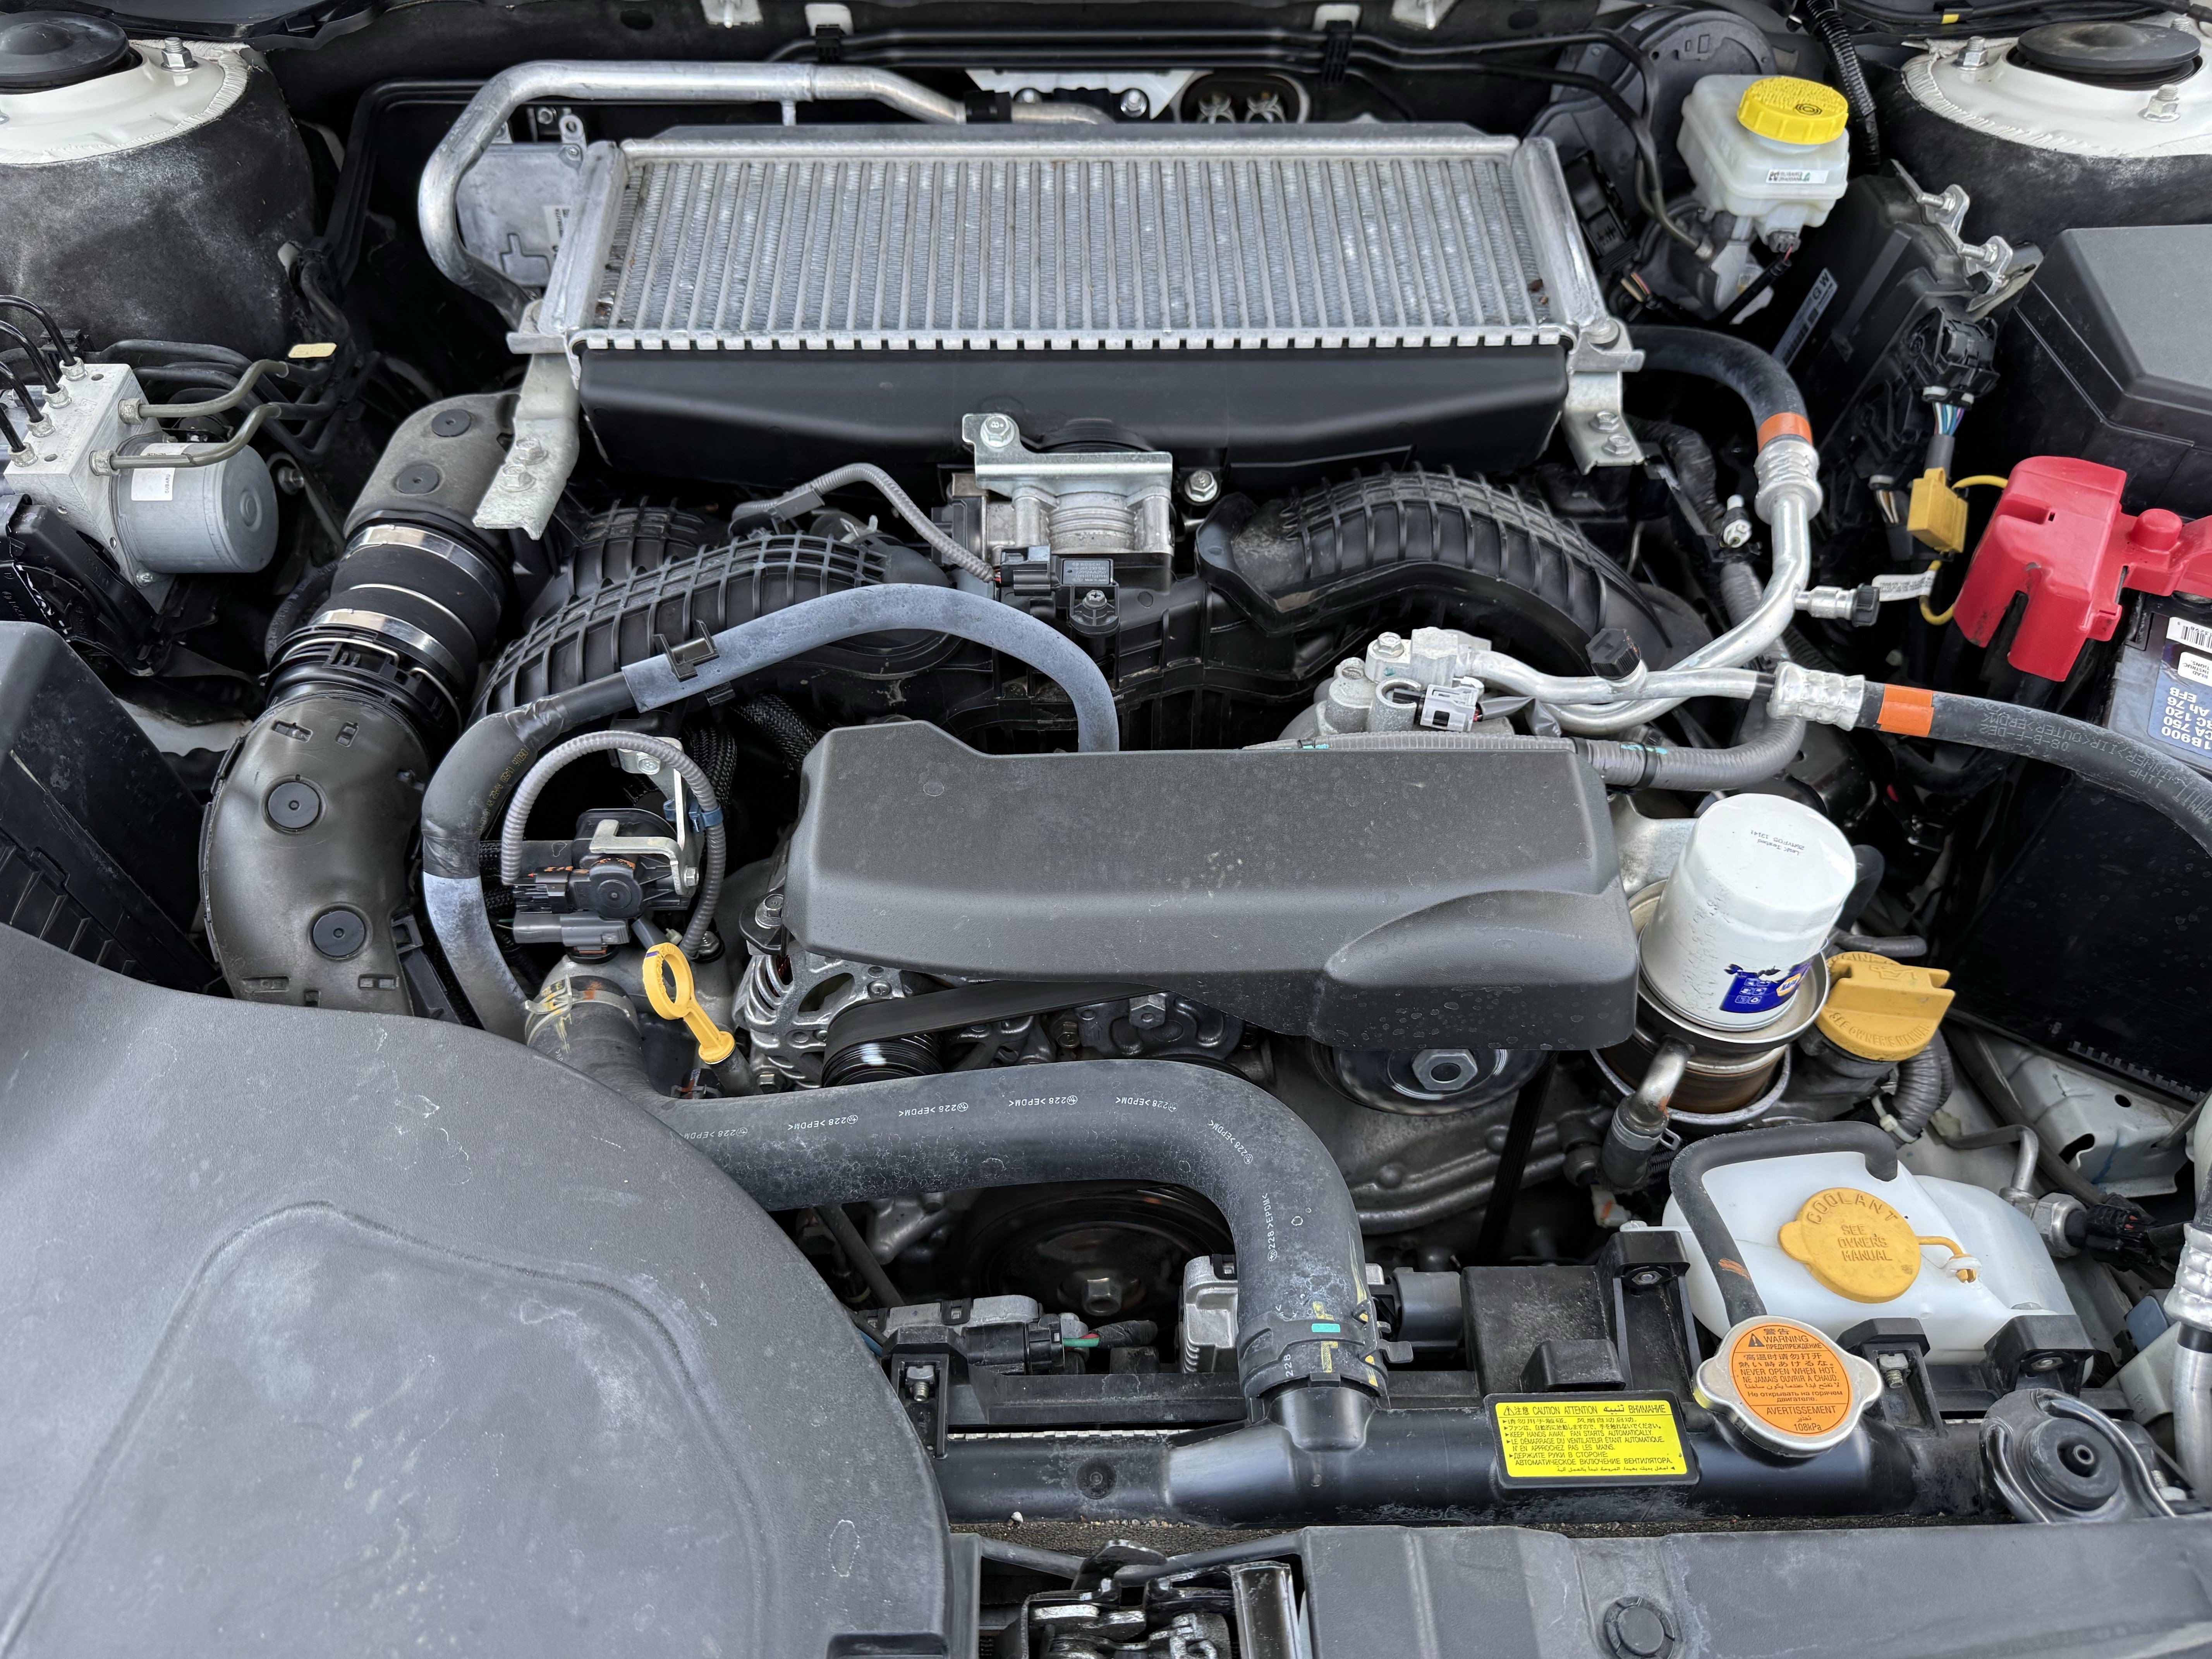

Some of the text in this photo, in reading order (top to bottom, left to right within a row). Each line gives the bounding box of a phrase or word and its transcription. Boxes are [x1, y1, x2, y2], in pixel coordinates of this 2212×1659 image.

[2169, 687, 2197, 703] EFB
[2167, 696, 2210, 717] Ah 76
[2165, 706, 2192, 721] 120
[2163, 716, 2190, 733] 750
[1829, 1012, 1930, 1048] SEE OWNER'S MANUAL
[939, 1104, 957, 1113] 228
[1152, 1100, 1168, 1109] 228
[828, 1116, 847, 1126] 228
[718, 1129, 736, 1138] 228
[1234, 1142, 1248, 1156] 228
[1807, 1192, 1898, 1224] COOLANT
[1841, 1224, 1867, 1235] SEE
[1838, 1233, 1888, 1248] OWNER'S
[1842, 1250, 1893, 1261] MANUAL
[1745, 1352, 1822, 1360] 高温时请勿打开
[1283, 1354, 1294, 1377] 228
[1532, 1406, 1560, 1415] CAUTION
[1565, 1405, 1598, 1415] ATTENTION
[1628, 1405, 1666, 1413] ВНИМАНИЕ
[1767, 1405, 1836, 1415] AVERTISSEMENT
[1793, 1423, 1822, 1431] 108kPa
